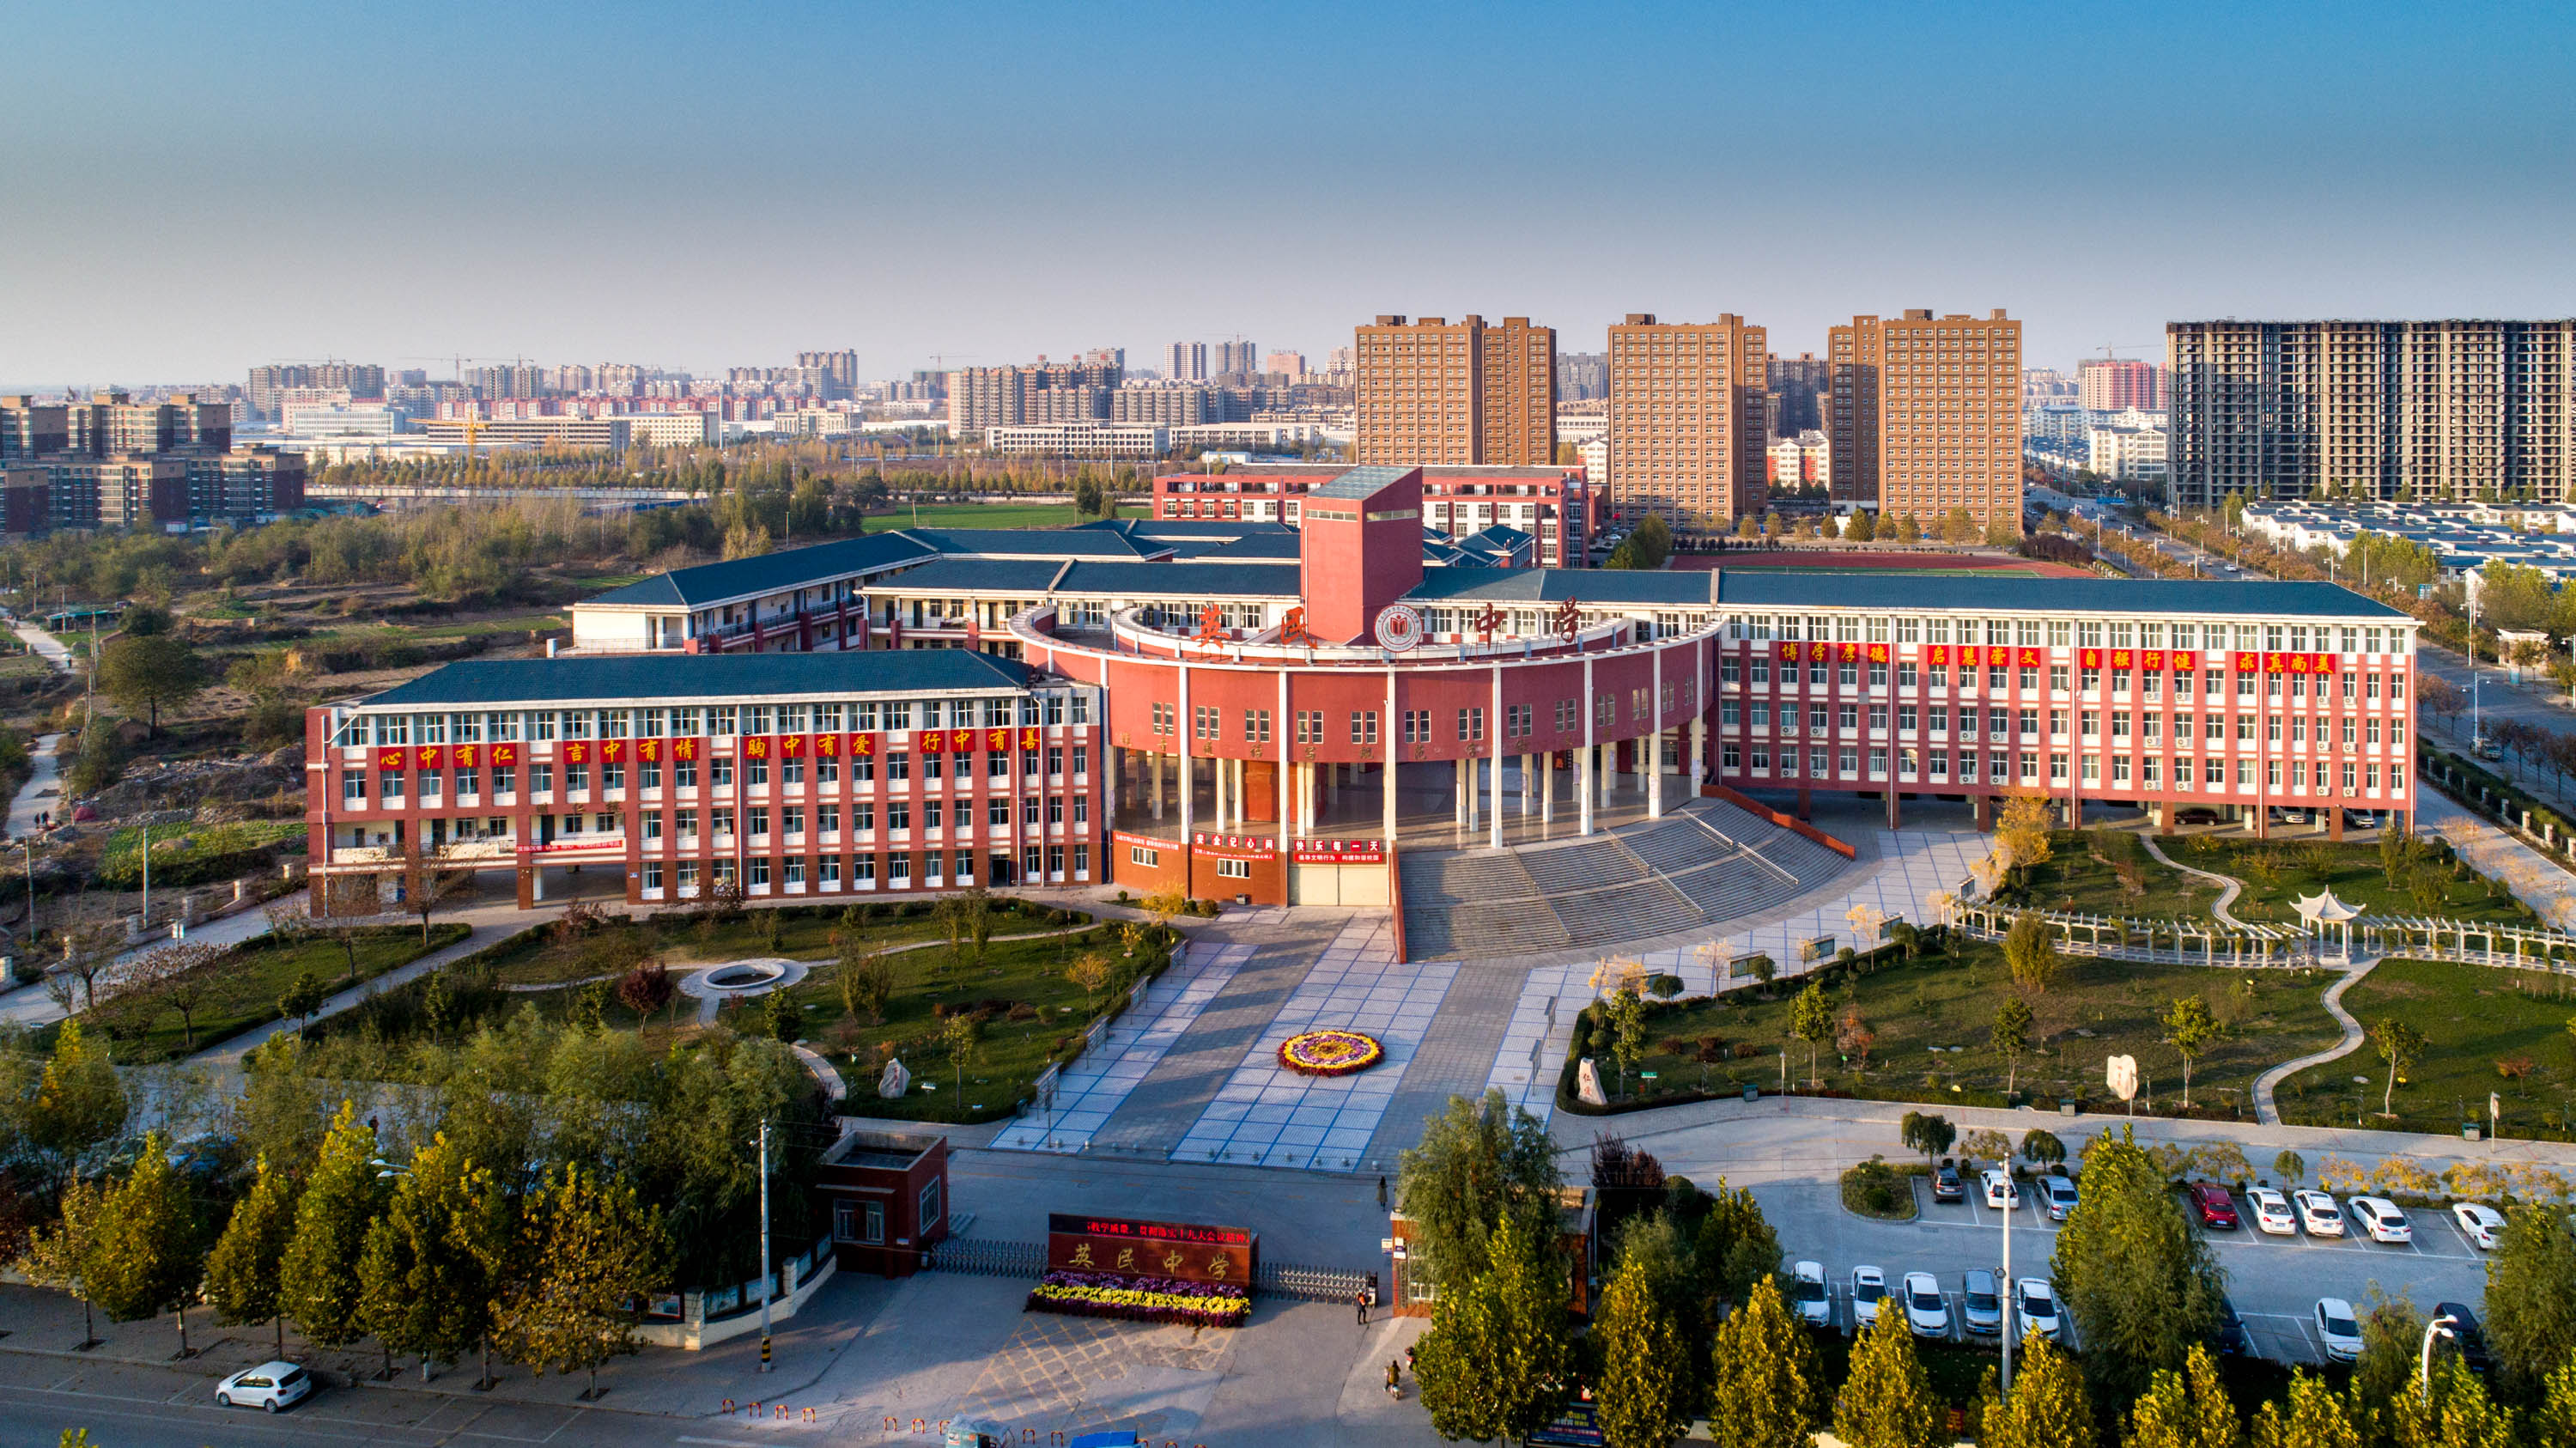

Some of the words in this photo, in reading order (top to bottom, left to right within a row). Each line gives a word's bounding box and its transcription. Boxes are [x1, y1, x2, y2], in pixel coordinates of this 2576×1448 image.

[1190, 596, 1582, 652] 英民中学
[1782, 642, 1888, 664] 博学厚德
[1929, 645, 2038, 667] 启慧崇文
[2084, 649, 2195, 672] 自强行健
[2238, 653, 2335, 675] 求真尚美
[380, 744, 513, 767] 心中有仁
[570, 739, 695, 762] 言中有情
[747, 733, 871, 757] 胸中有爱
[922, 727, 1040, 751] 行中有善
[1196, 834, 1273, 849] 安全记心间
[1296, 840, 1377, 851] 快乐每一天
[1069, 1244, 1230, 1281] 英民中学
